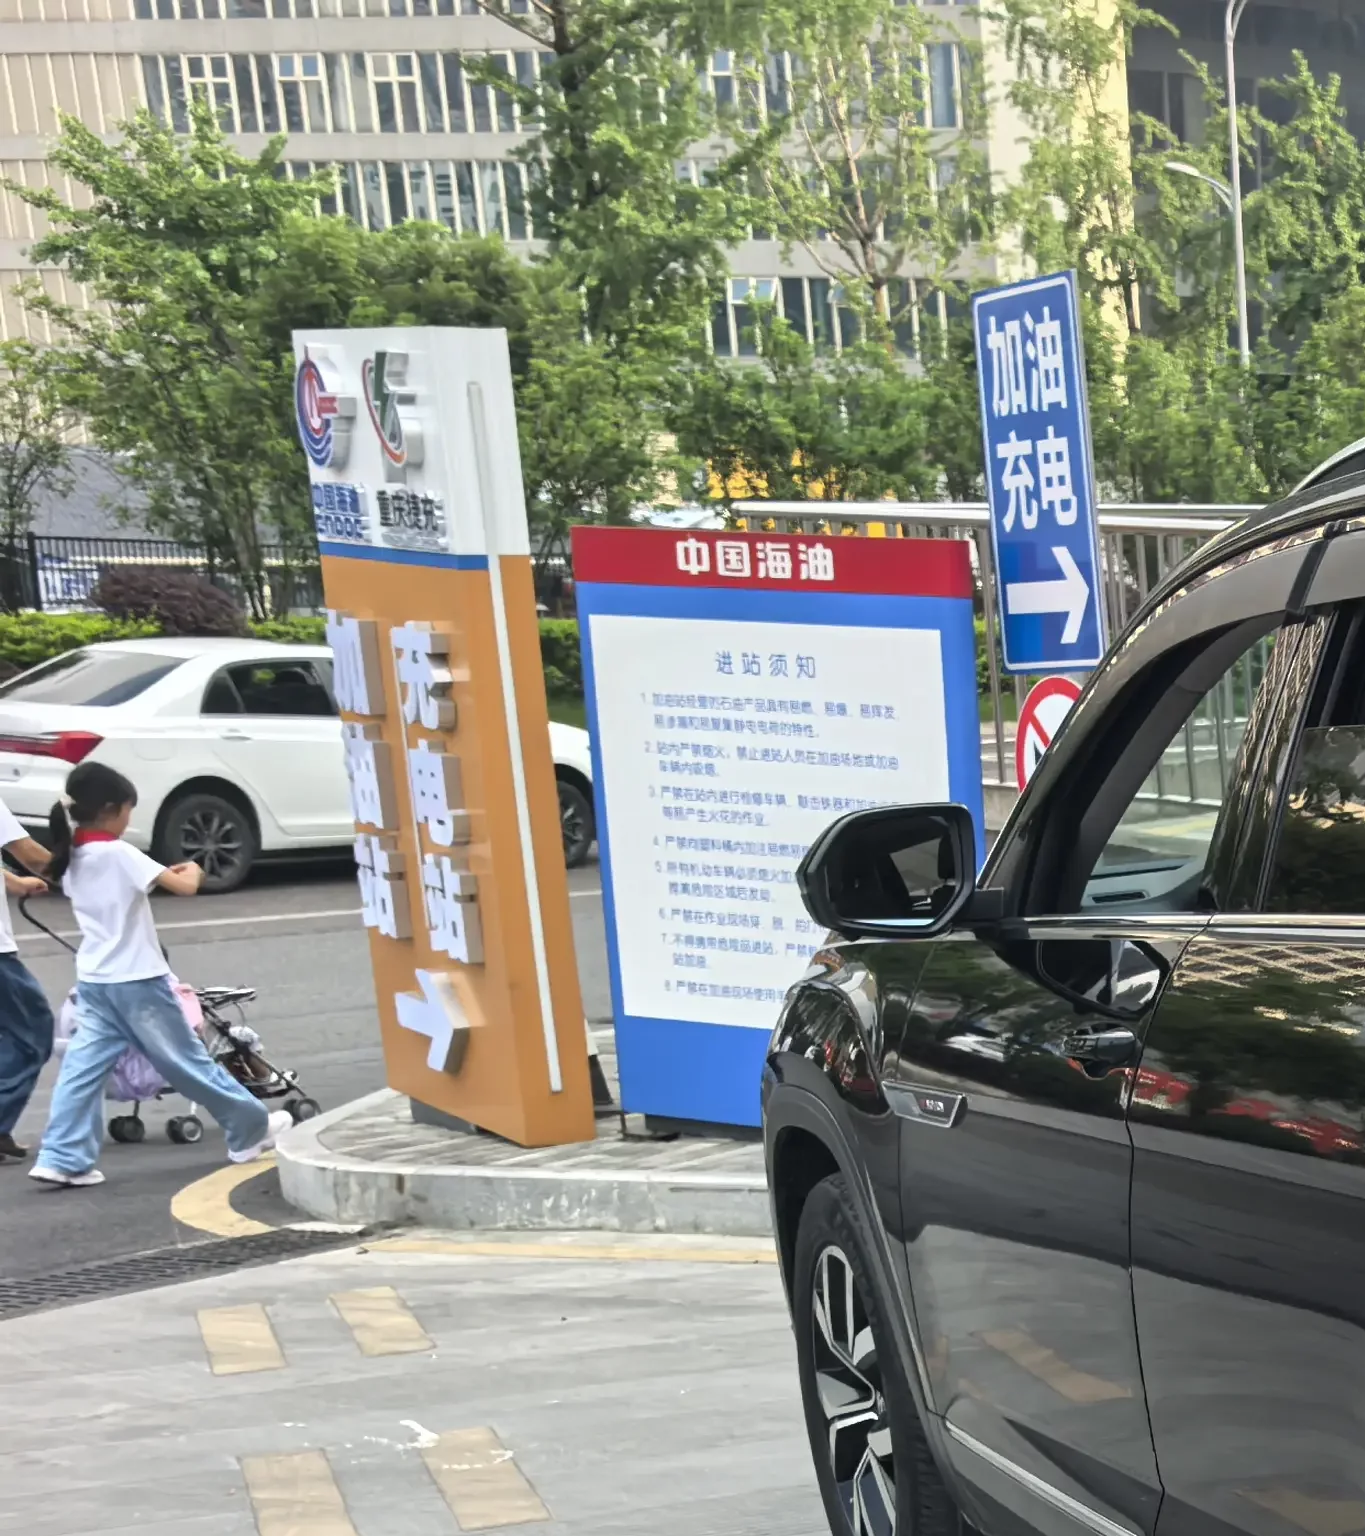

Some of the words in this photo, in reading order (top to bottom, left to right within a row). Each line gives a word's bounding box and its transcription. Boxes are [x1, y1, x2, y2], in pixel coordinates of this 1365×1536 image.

[986, 305, 1068, 418] 加油
[997, 425, 1078, 534] 充电
[675, 537, 835, 581] 中国海油
[714, 650, 818, 680] 进站须知
[391, 620, 469, 964] 充电站
